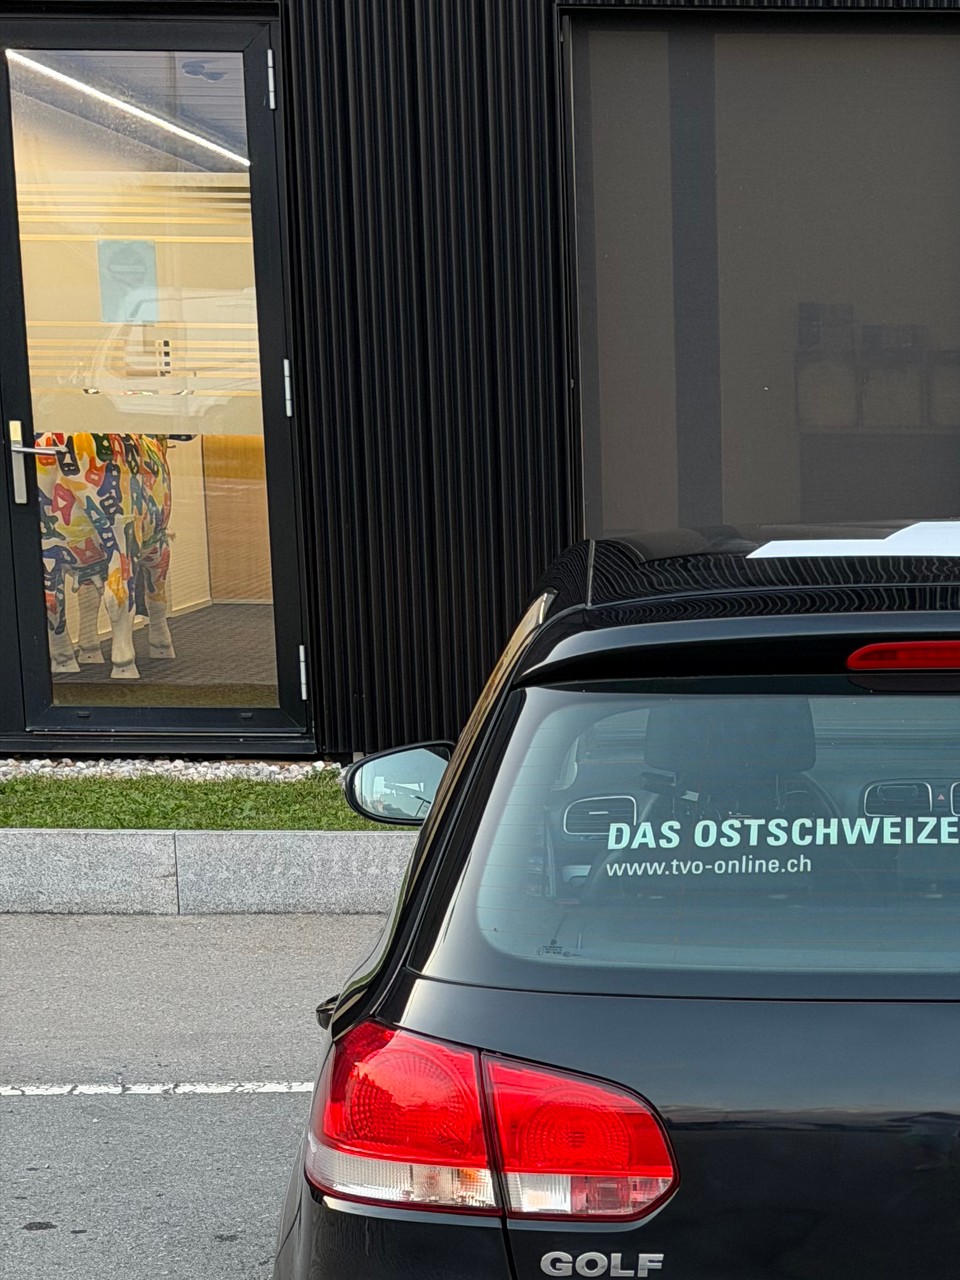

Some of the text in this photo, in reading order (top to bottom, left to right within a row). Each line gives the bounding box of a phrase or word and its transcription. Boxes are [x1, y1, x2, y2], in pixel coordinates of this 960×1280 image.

[607, 820, 681, 850] DAS
[606, 854, 812, 876] www.tvo-online.ch
[540, 1251, 664, 1277] GOLF
